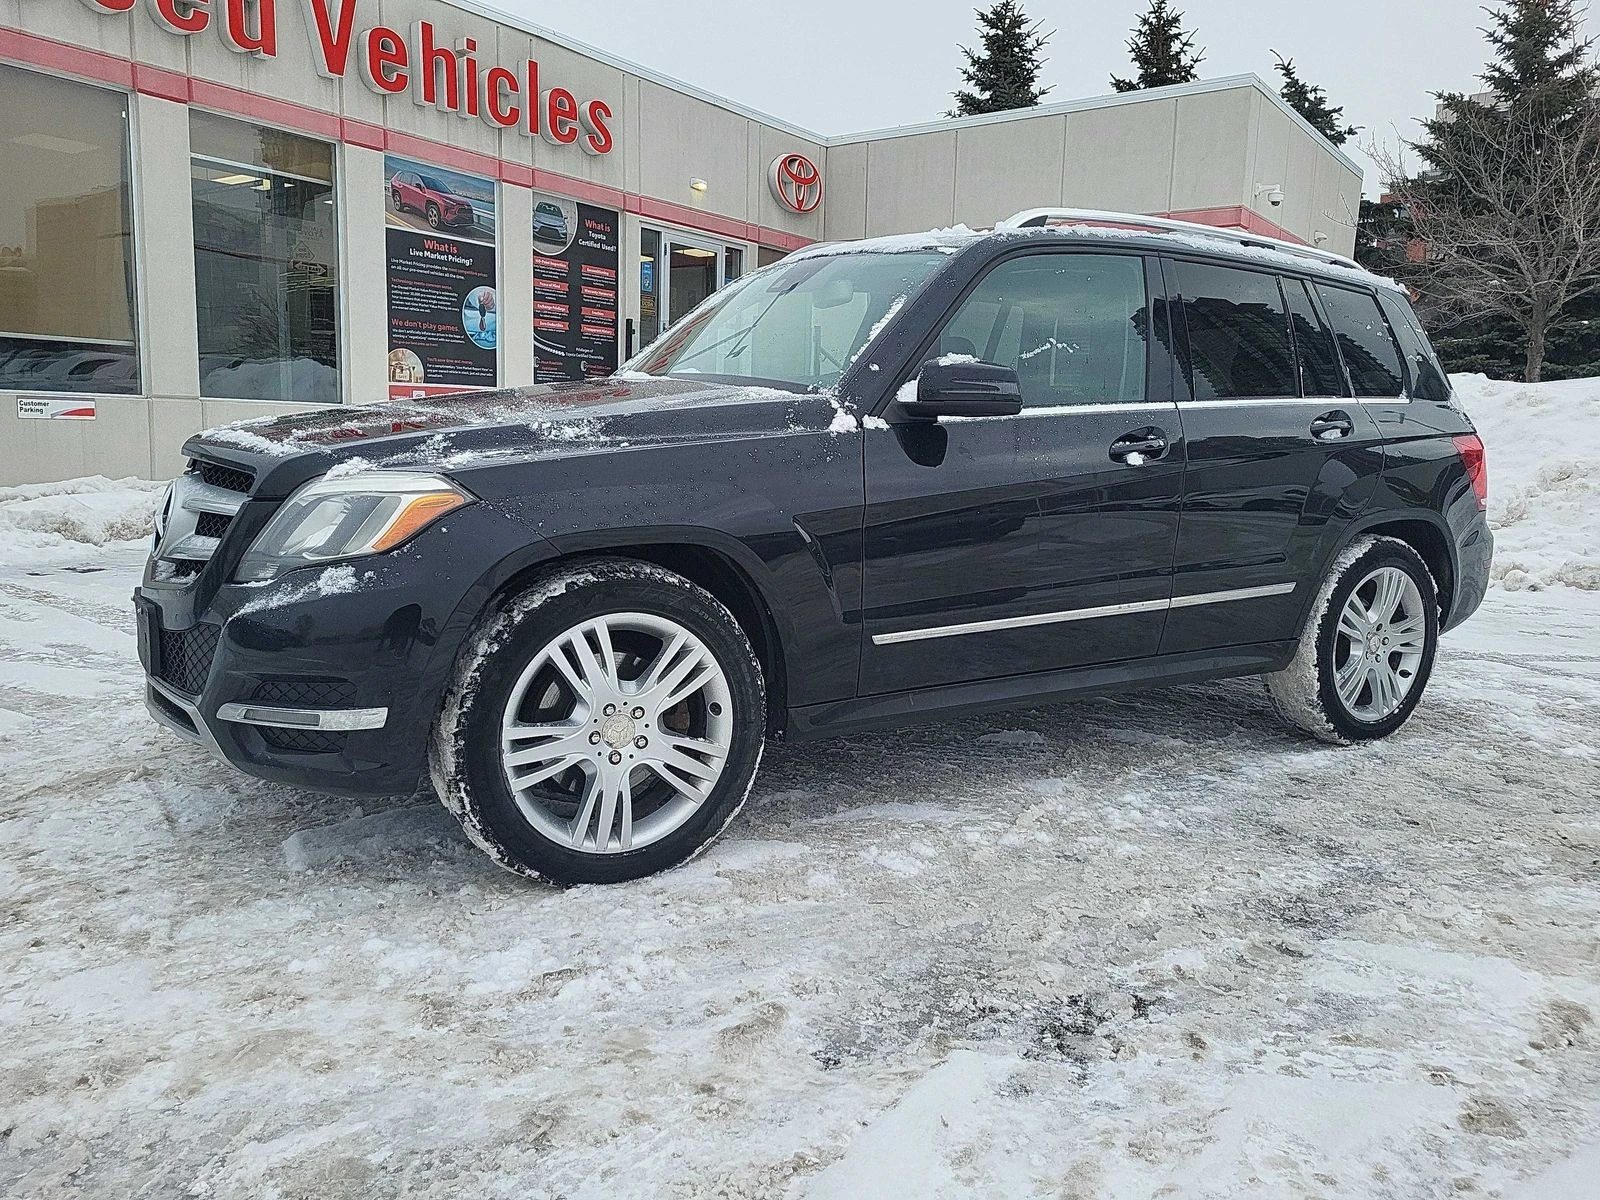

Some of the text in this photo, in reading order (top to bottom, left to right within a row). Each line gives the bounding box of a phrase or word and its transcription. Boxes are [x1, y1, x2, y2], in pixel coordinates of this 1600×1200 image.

[308, 0, 614, 155] Vehicles
[584, 218, 610, 232] What is
[588, 230, 606, 240] Toyota
[423, 238, 458, 254] What is
[578, 238, 616, 252] Certified Used?
[410, 248, 473, 266] Live Market Pricing?
[392, 318, 404, 327] We
[404, 320, 422, 328] don't
[422, 322, 437, 330] play
